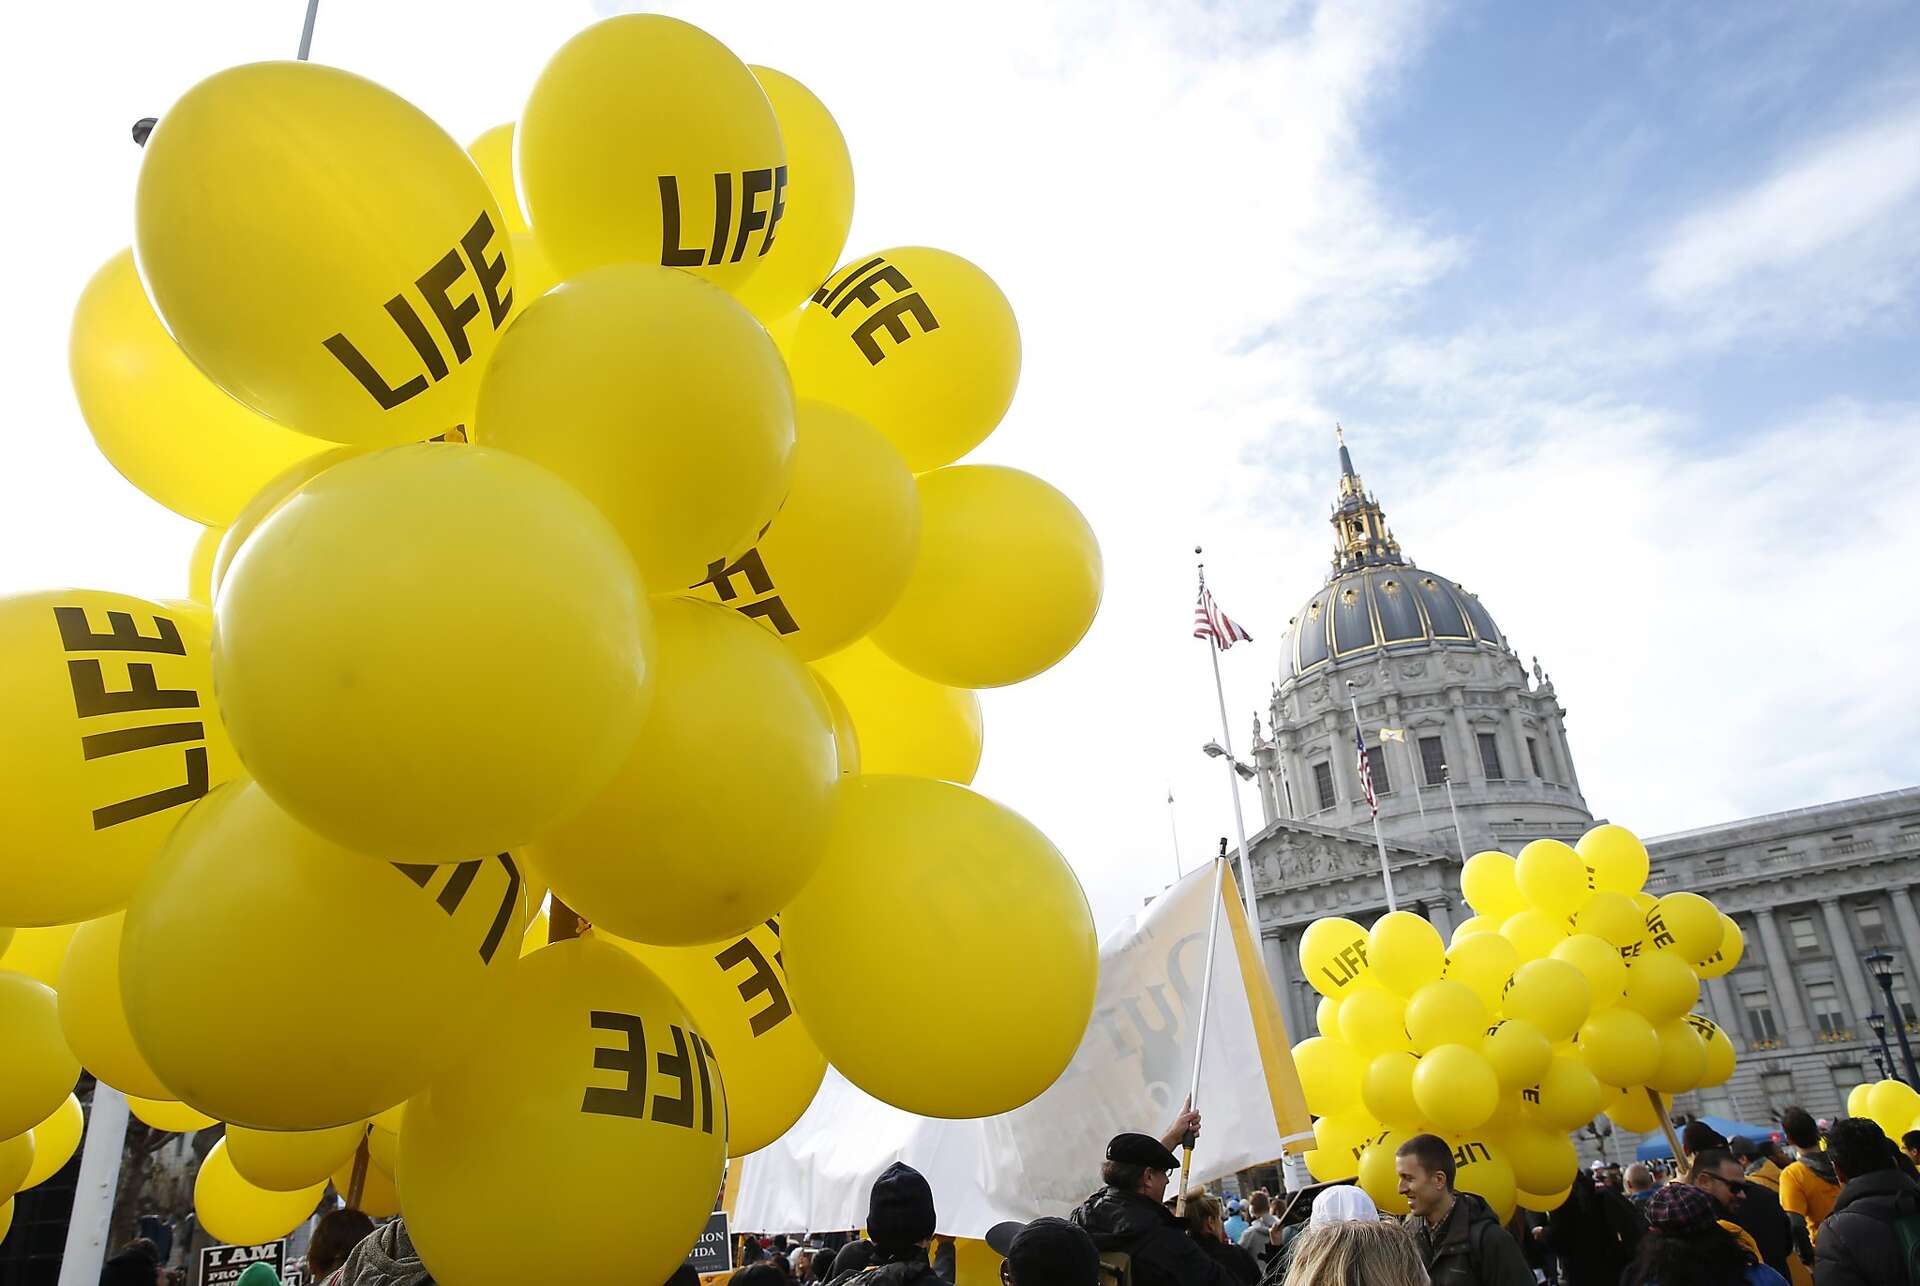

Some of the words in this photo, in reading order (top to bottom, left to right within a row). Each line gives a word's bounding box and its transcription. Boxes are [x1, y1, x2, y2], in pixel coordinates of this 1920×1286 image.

[658, 165, 788, 267] LIFE
[322, 210, 513, 411] LIFE
[53, 606, 209, 831] LIFE
[1453, 1142, 1492, 1168] LIF
[209, 1251, 222, 1266] I
[227, 1244, 278, 1263] AM
